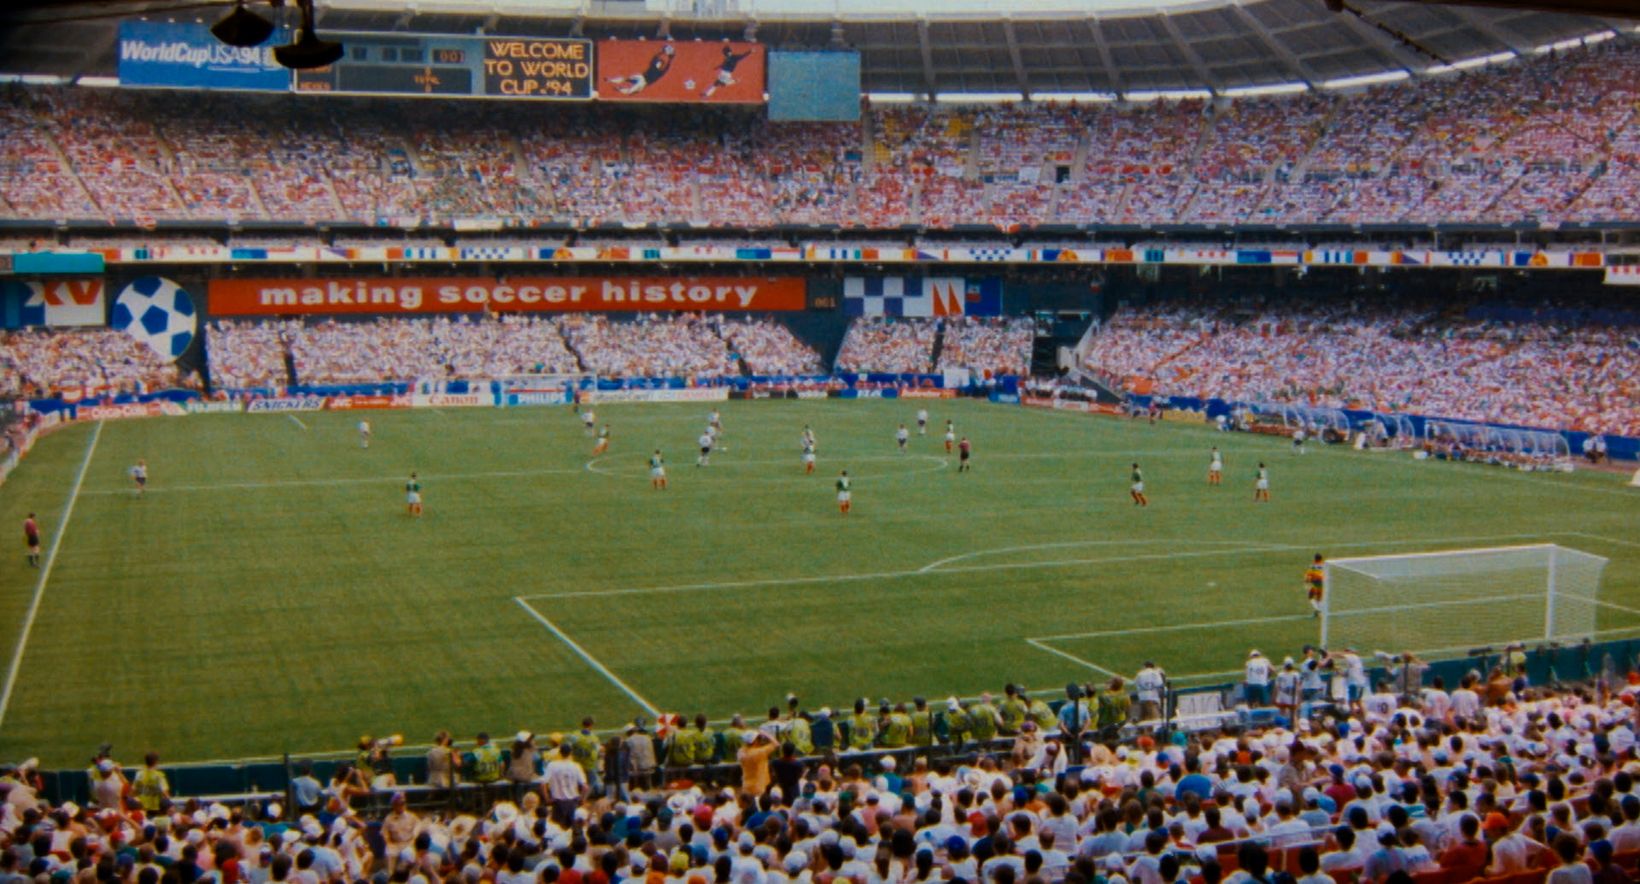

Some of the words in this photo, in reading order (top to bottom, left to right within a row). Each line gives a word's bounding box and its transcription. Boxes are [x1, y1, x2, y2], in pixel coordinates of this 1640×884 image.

[490, 42, 584, 59] WELCOME
[484, 59, 512, 76] TO
[520, 61, 590, 78] WORLD
[260, 282, 424, 309] making
[438, 281, 587, 304] soccer
[601, 279, 758, 307] history
[253, 400, 321, 409] SNICKERS
[428, 394, 479, 404] Canon
